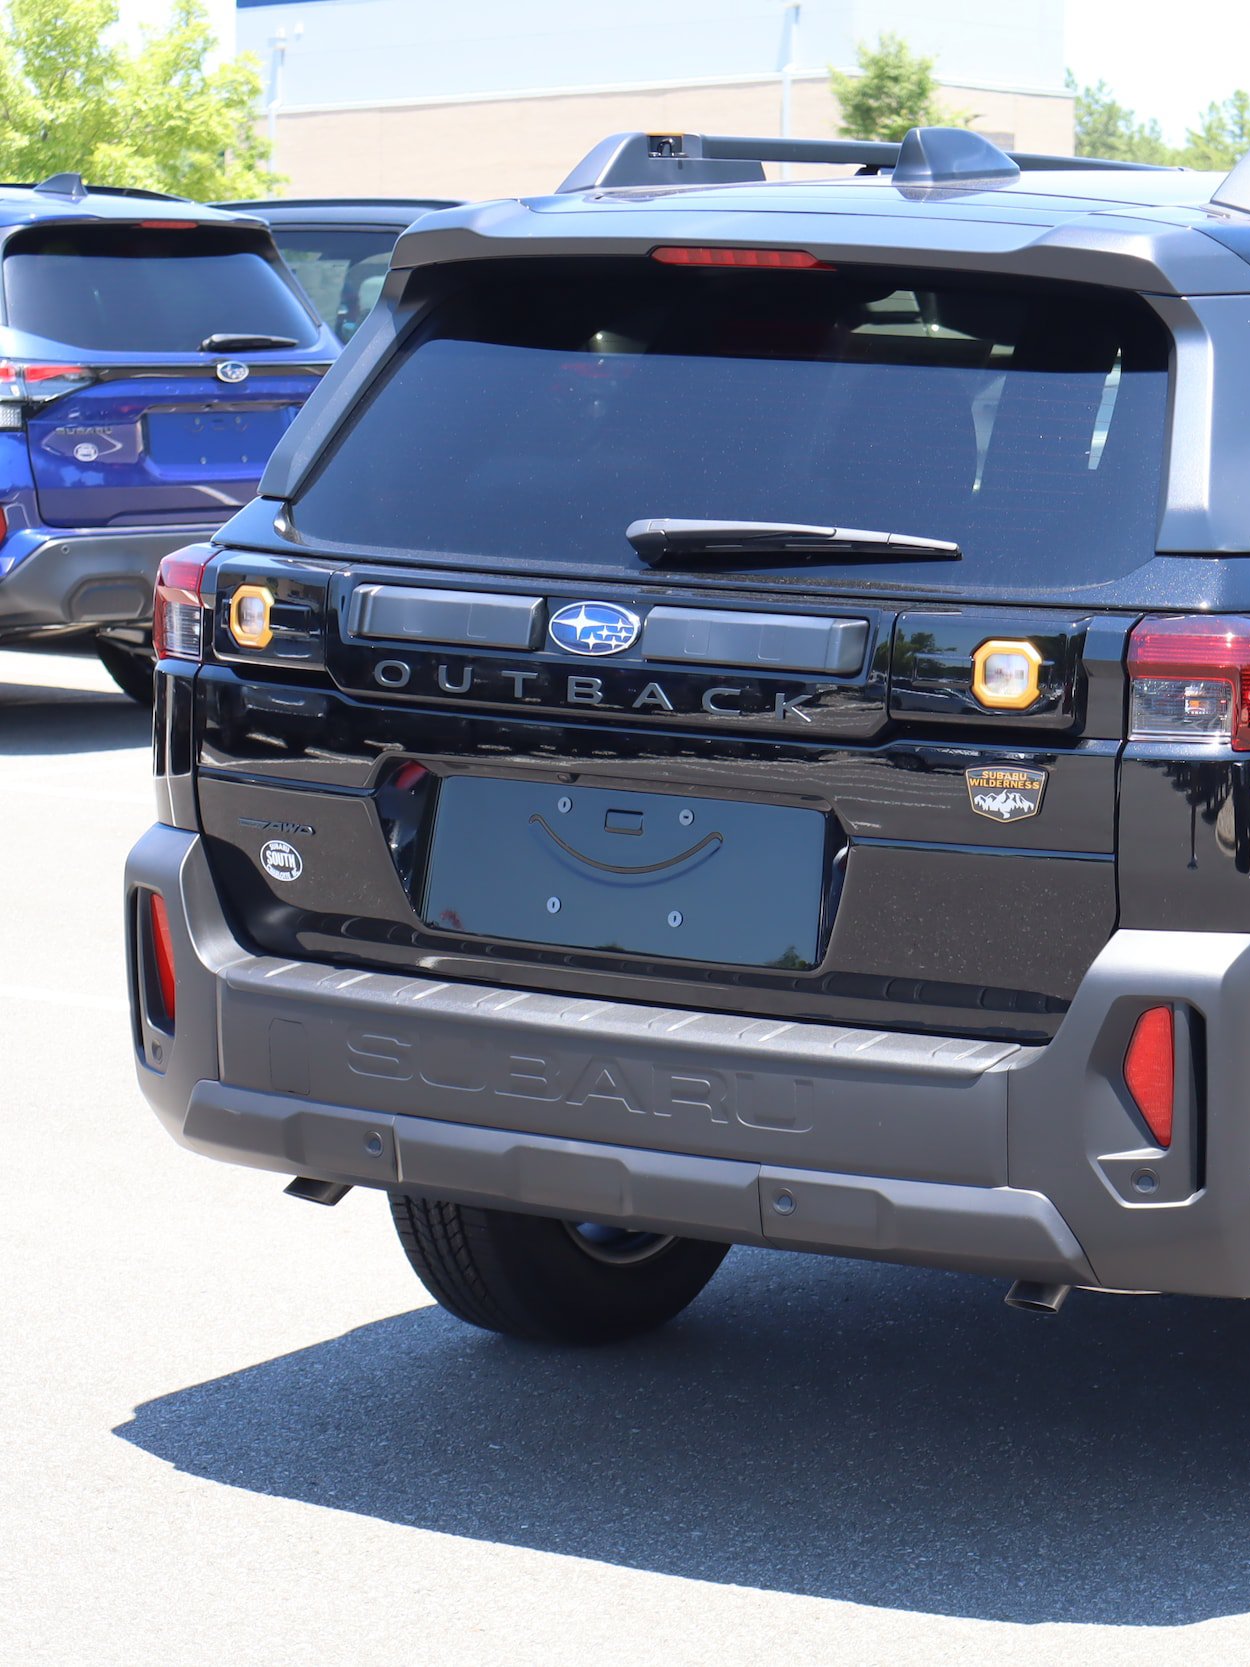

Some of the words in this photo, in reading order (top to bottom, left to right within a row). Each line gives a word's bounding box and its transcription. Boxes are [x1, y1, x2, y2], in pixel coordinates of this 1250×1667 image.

[374, 659, 814, 723] OUTBACK
[970, 778, 1040, 790] WILDERNESS
[981, 770, 1027, 781] SUBARU
[265, 850, 297, 868] SOUTH
[346, 1032, 815, 1134] SUBARU
